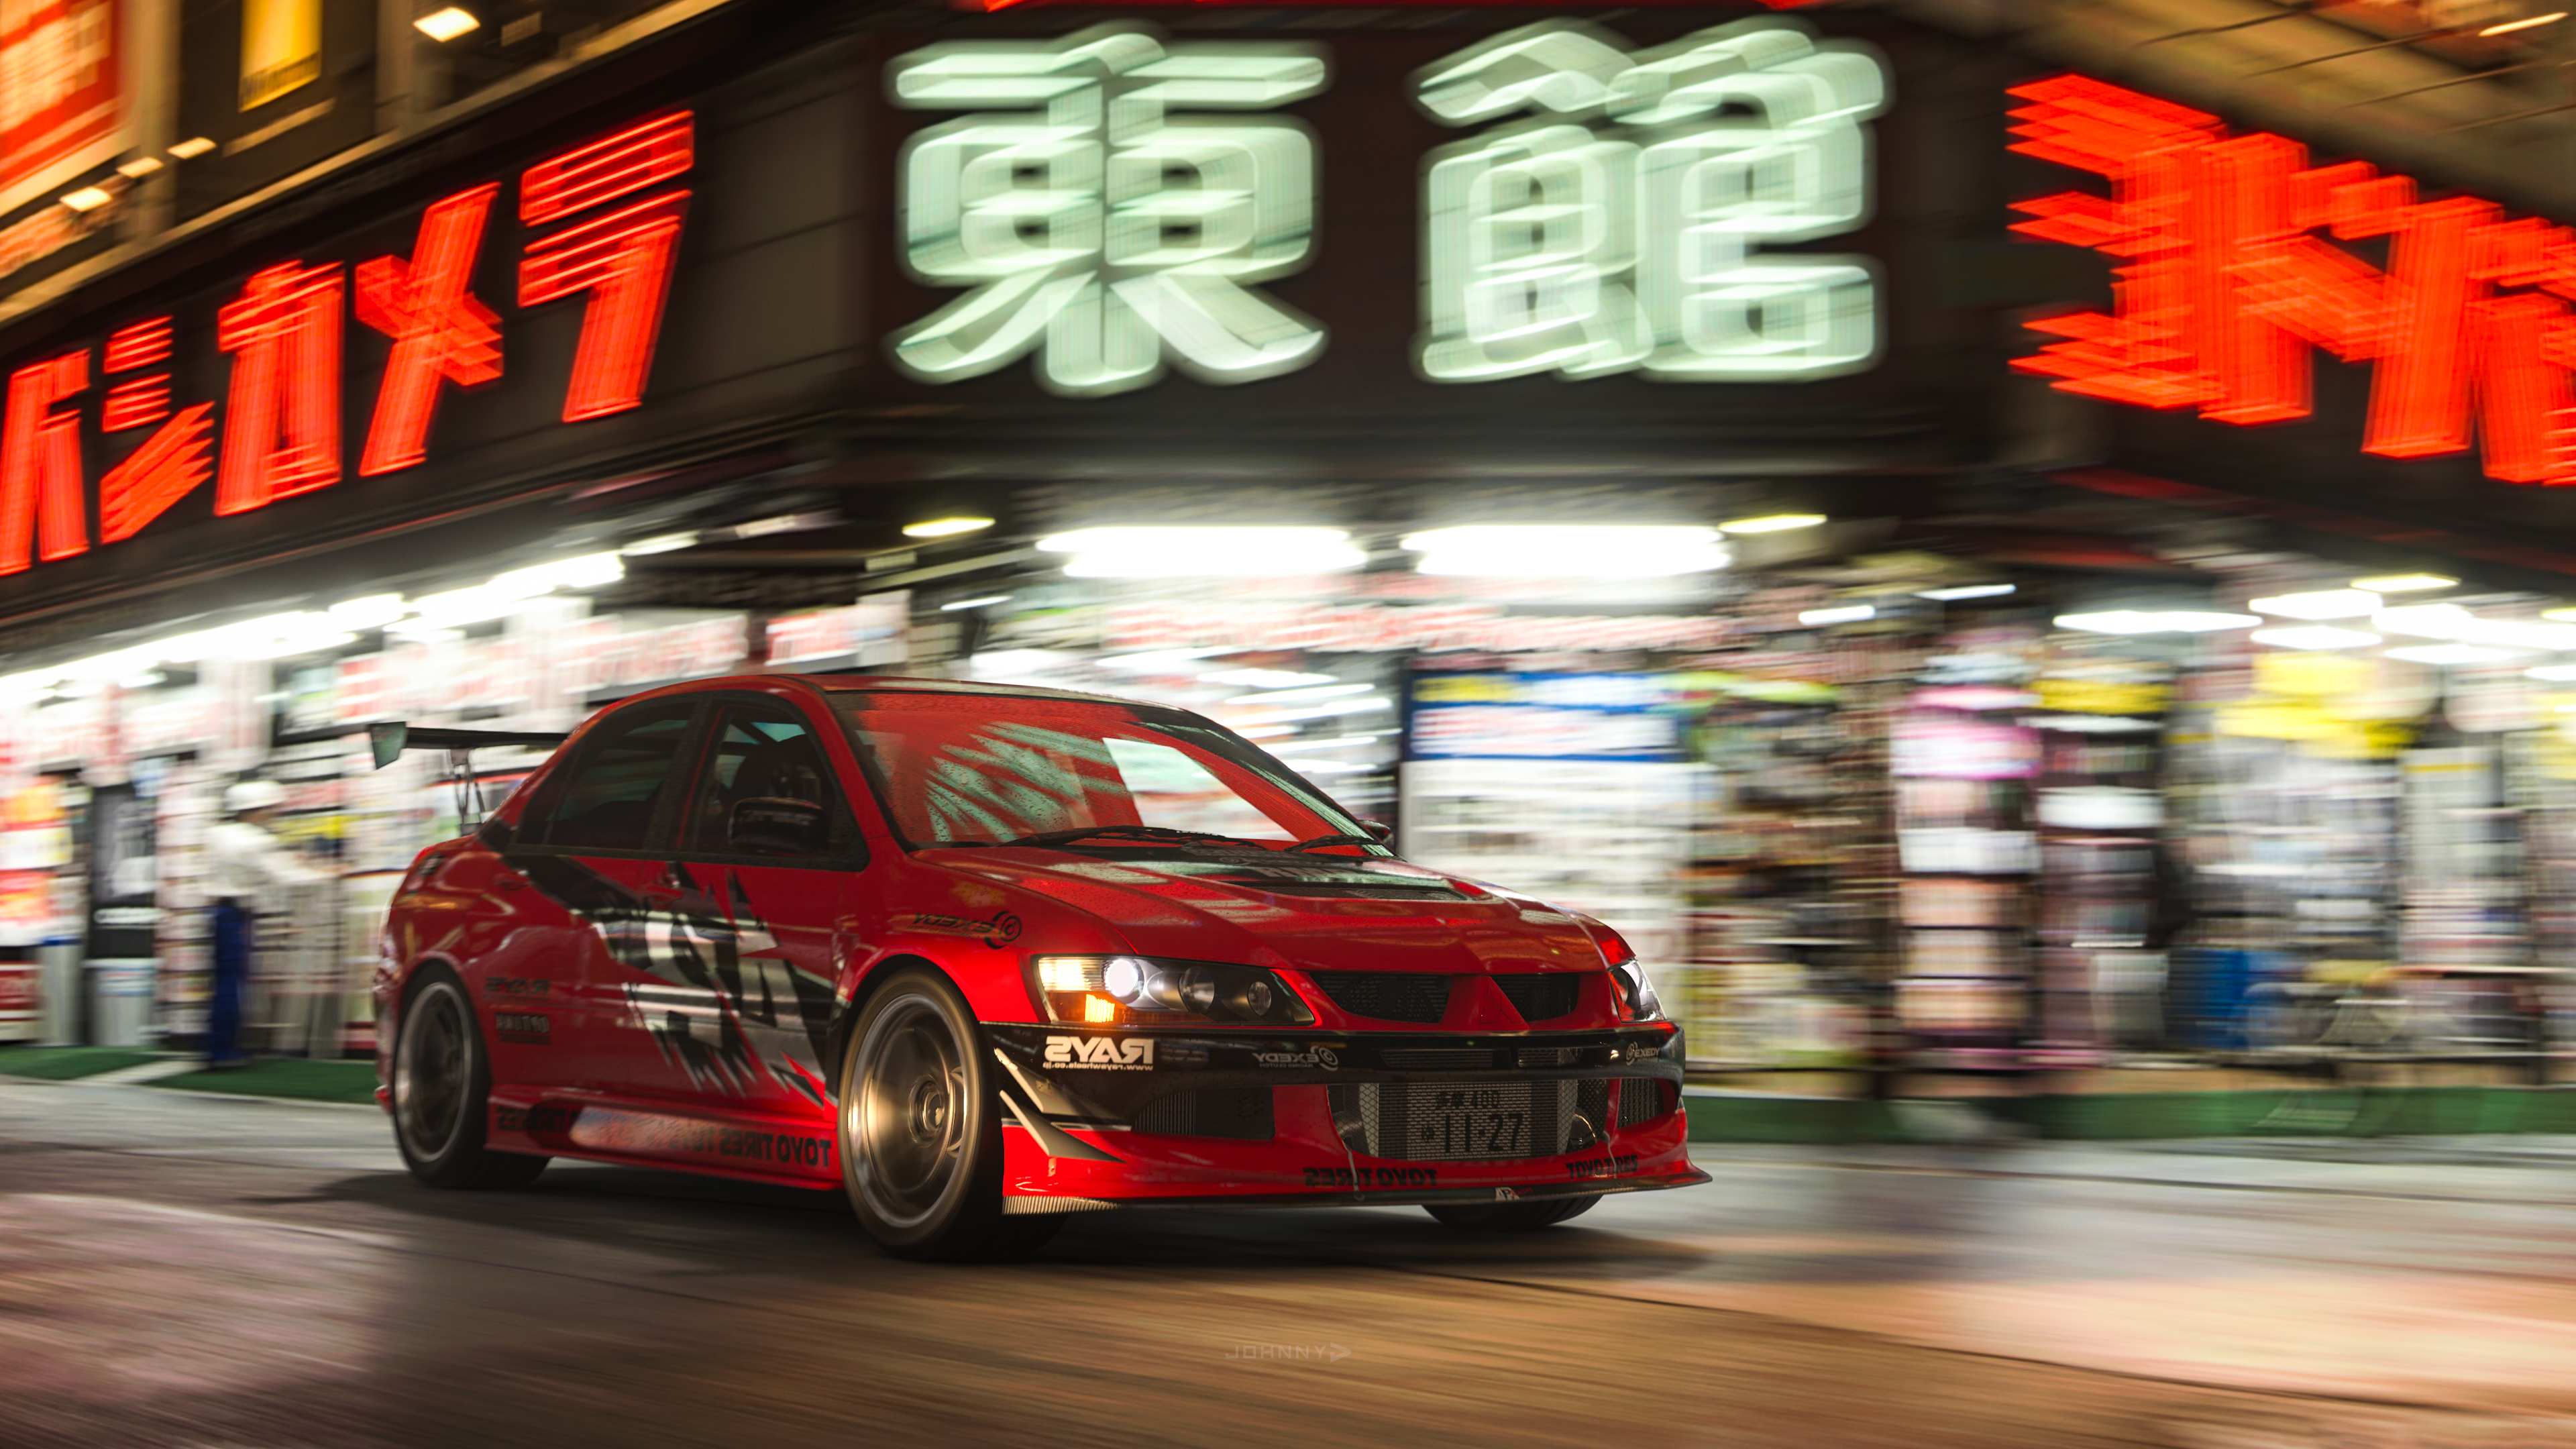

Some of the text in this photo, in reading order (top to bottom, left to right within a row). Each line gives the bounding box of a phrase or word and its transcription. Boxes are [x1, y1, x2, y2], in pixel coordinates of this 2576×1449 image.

[892, 25, 1890, 392] 東館
[1634, 1047, 1660, 1058] EXEDY
[1564, 1158, 1603, 1179] TOYO
